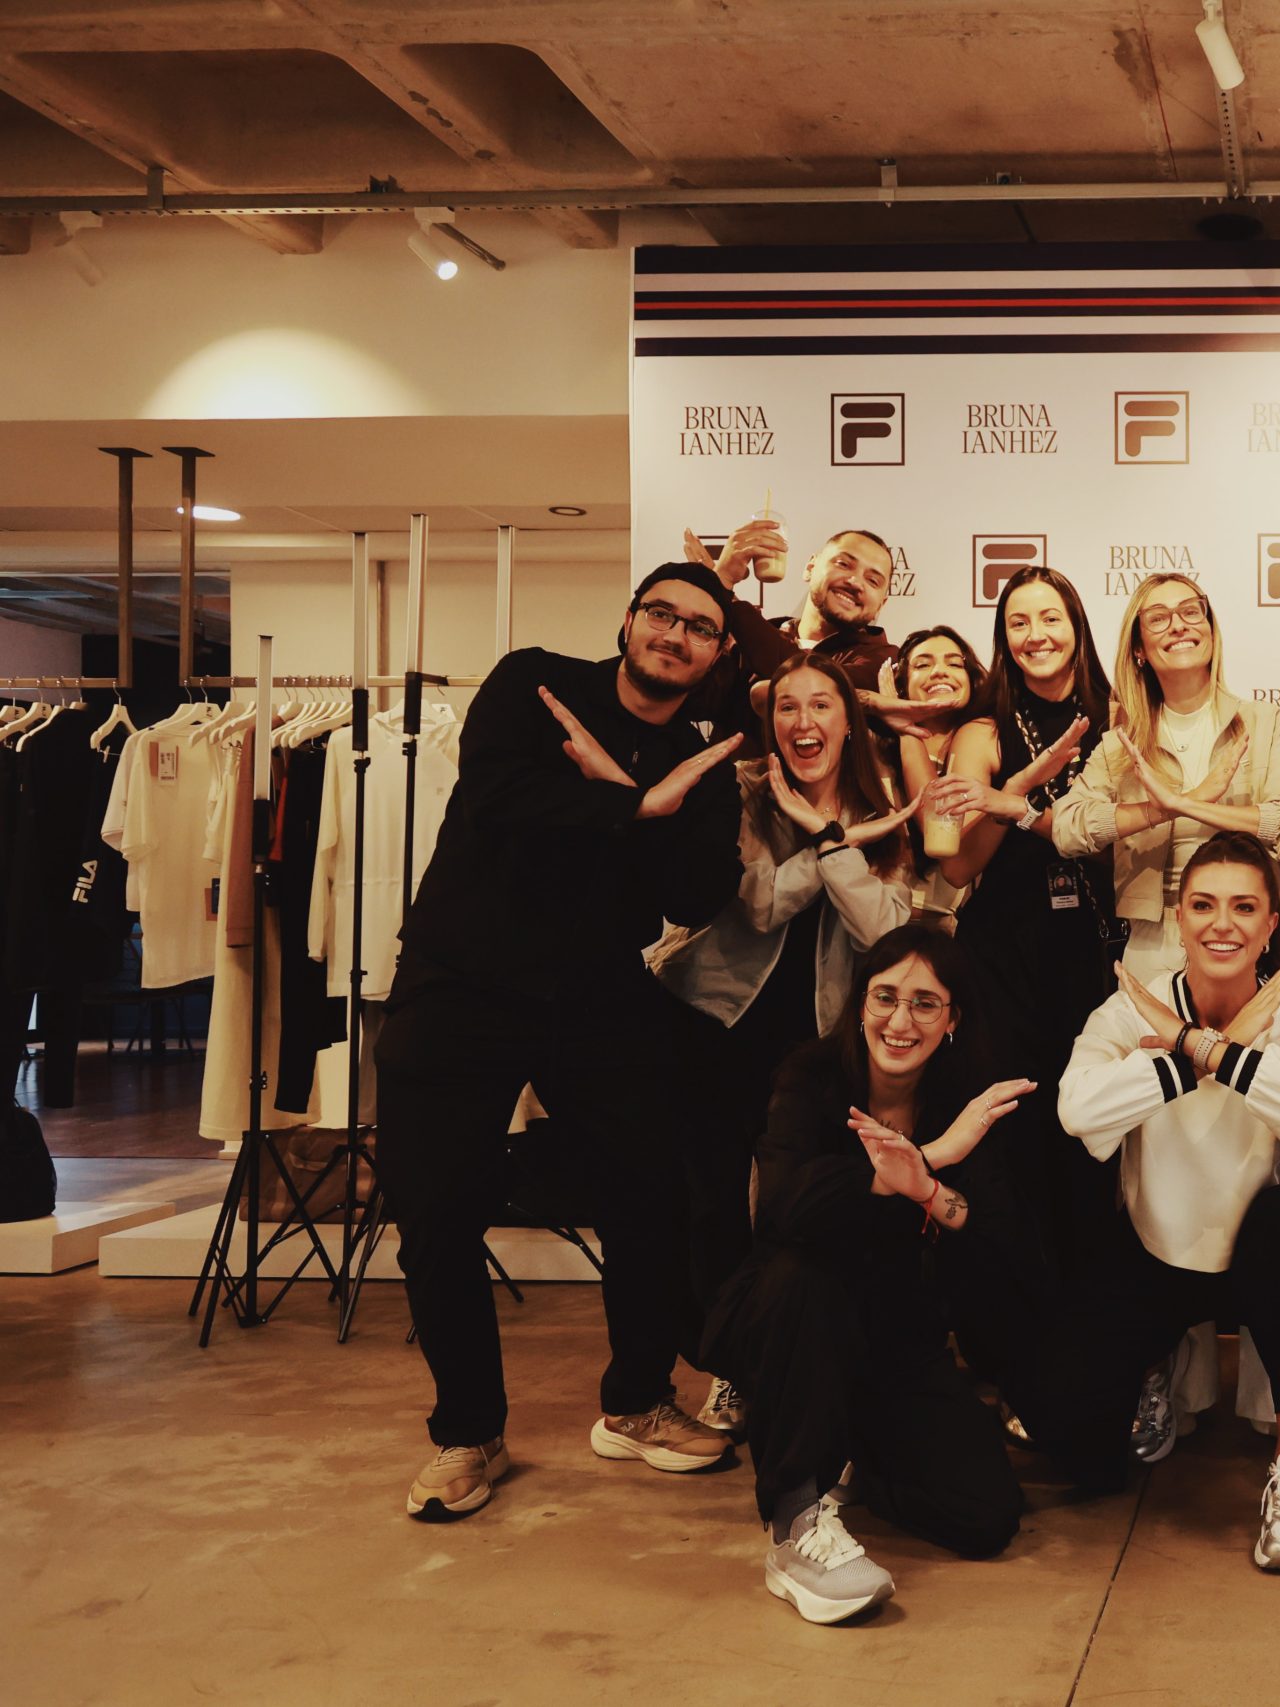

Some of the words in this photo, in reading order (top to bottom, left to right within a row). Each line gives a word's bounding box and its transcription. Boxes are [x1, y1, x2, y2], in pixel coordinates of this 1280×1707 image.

[685, 406, 768, 429] BRUNA
[968, 404, 1051, 427] BRUNA
[681, 432, 774, 455] IANHEZ
[962, 430, 1057, 453] IANHEZ
[1110, 545, 1194, 569] BRUNA
[72, 859, 98, 904] FILA
